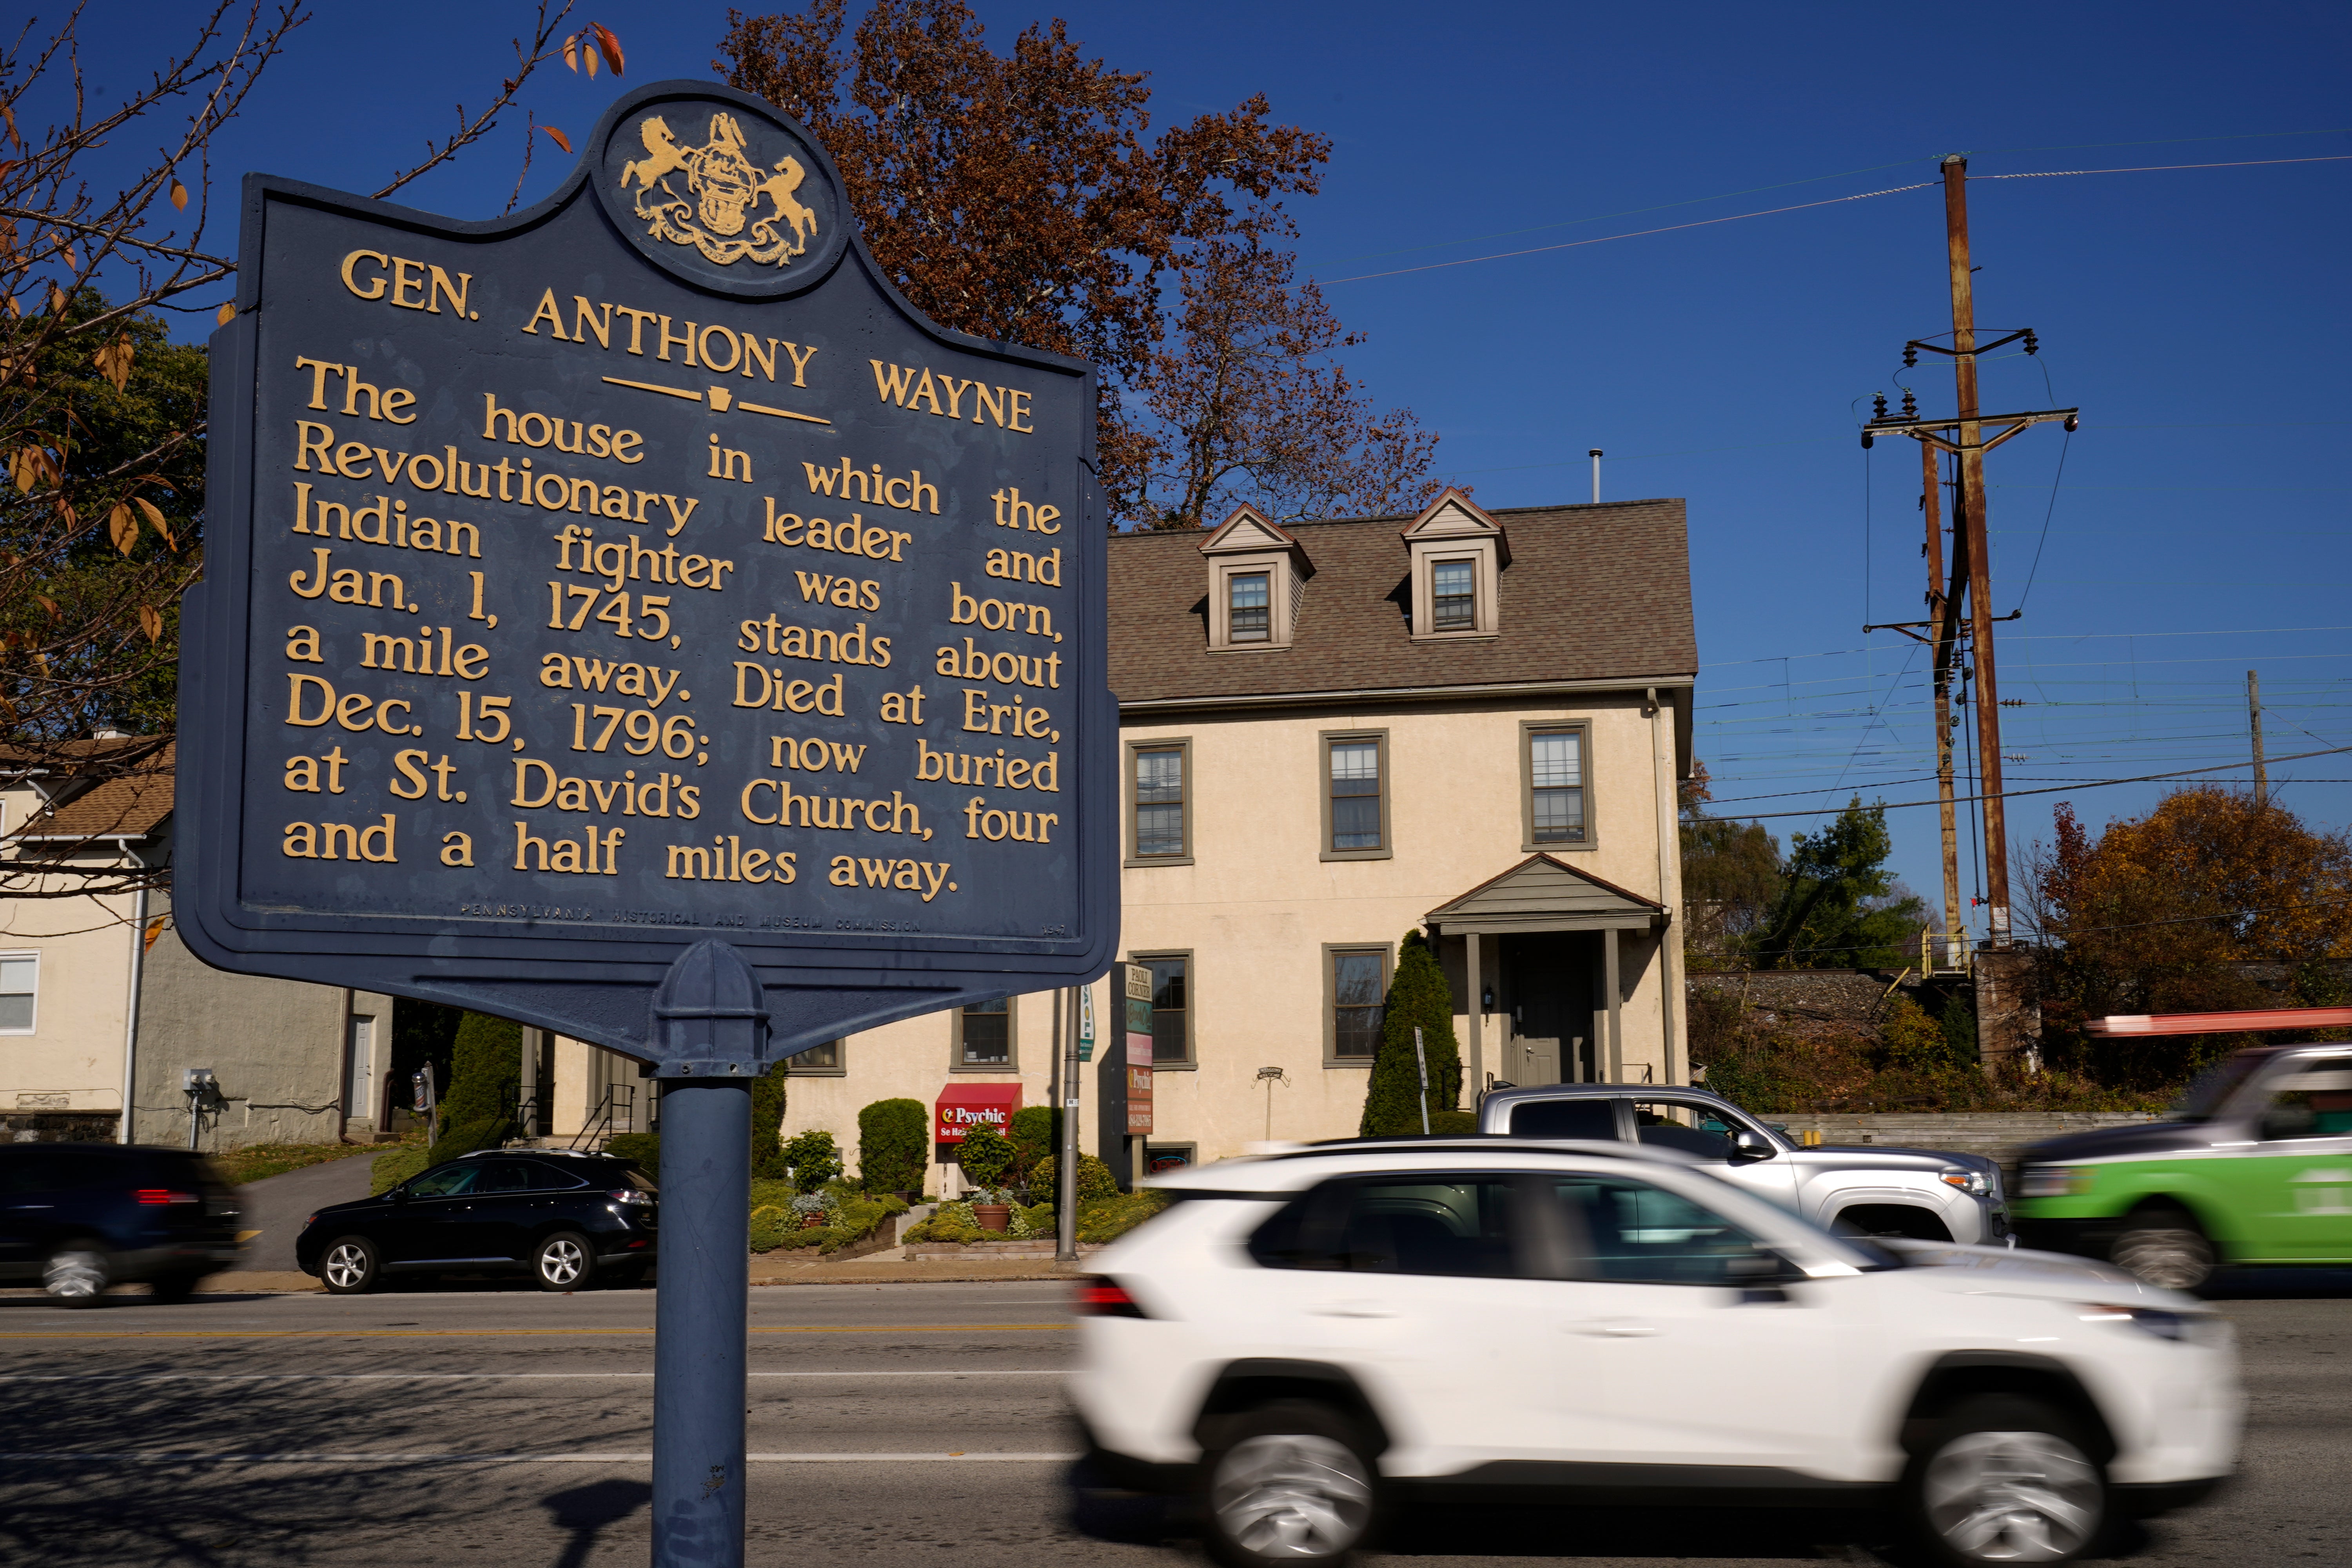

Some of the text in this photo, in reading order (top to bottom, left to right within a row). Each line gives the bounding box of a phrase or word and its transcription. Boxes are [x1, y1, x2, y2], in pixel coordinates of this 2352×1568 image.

[341, 250, 1033, 433] GEN. ANTHONY WAYNE
[296, 356, 1061, 534] The house in which the
[295, 421, 1060, 586] Revolutionary leader and
[293, 483, 1062, 642] Indian fighter was born,
[290, 548, 1062, 688] Jan. 1, 1745, stands about
[287, 626, 1059, 743] a mile away. Died at Erie,
[285, 674, 1059, 791] Dec. 15, 1796; now buried
[285, 747, 1058, 842] at St. David's Church, four
[283, 814, 957, 901] and a half miles away.
[461, 904, 921, 931] PENNSYLVANIA HISTORICAL AND MUSEUM COMMISSION
[1128, 982, 1150, 998] CORNER
[1131, 968, 1147, 984] PAOLI
[955, 1107, 1006, 1126] Psychic
[1133, 1069, 1152, 1094] Psychic
[941, 1127, 951, 1136] Se
[1150, 1160, 1185, 1173] OPEN
